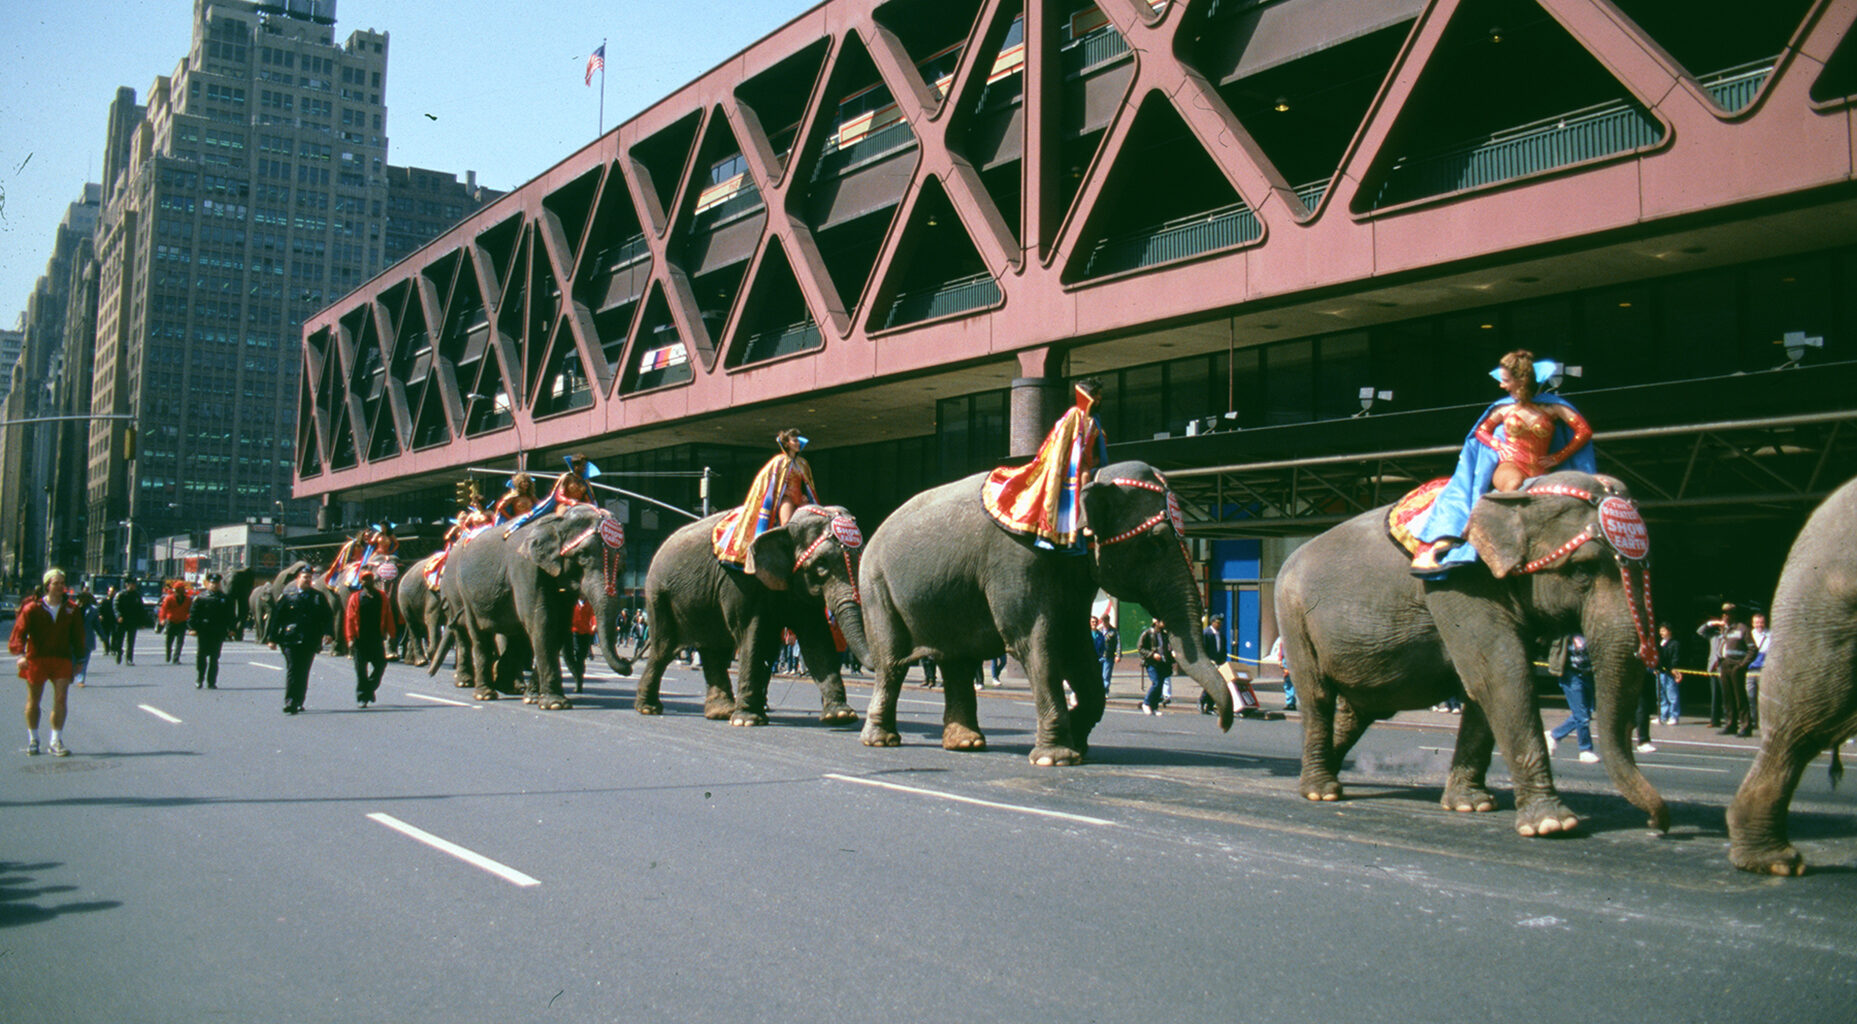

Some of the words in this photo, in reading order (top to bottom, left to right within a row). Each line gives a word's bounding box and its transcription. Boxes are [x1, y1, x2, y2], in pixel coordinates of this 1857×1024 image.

[604, 526, 623, 538] SHOW
[836, 526, 859, 536] SHOW
[1607, 519, 1645, 536] SHOW
[1615, 536, 1647, 550] EARTH
